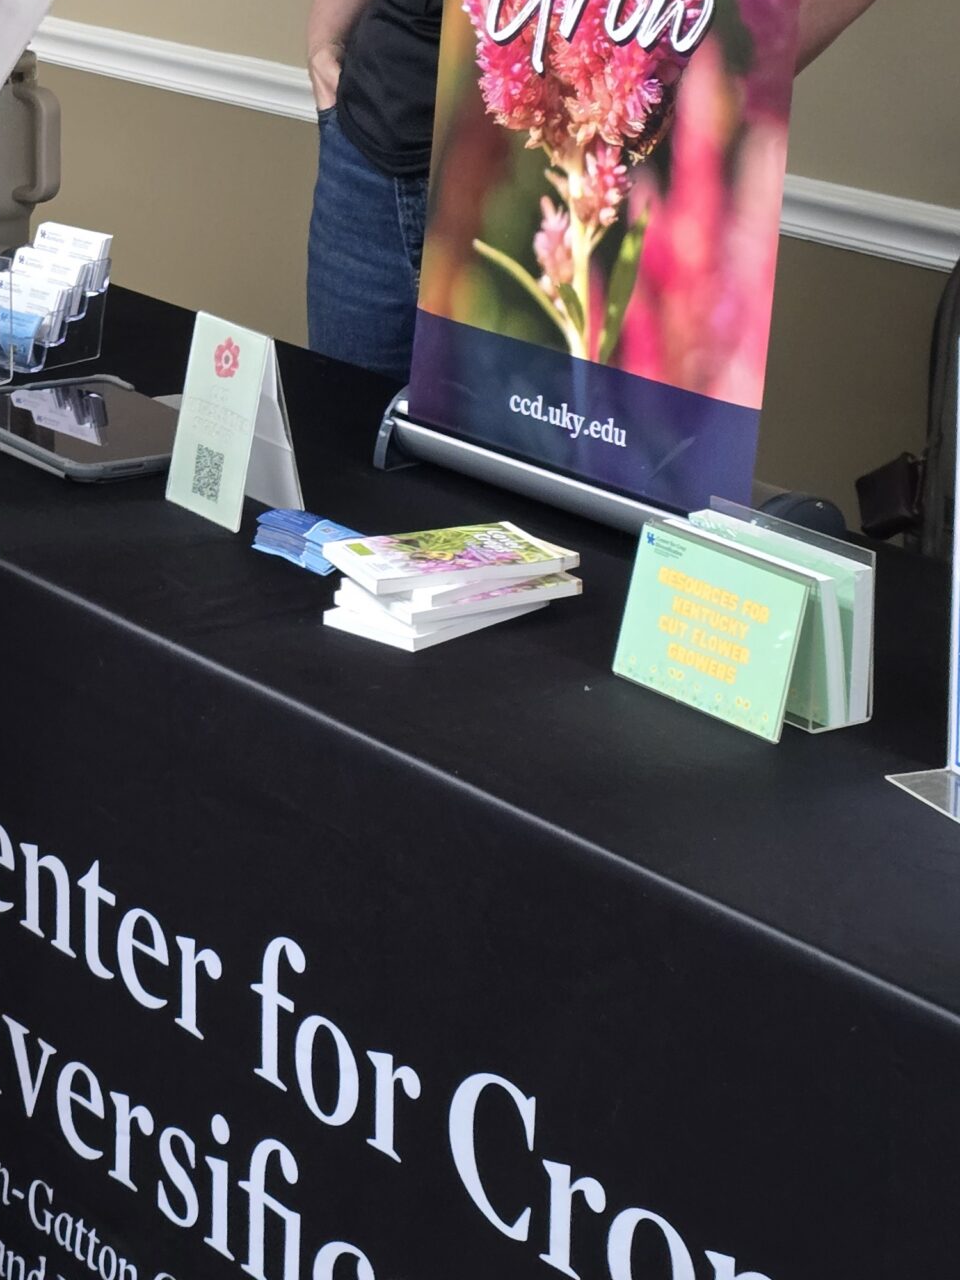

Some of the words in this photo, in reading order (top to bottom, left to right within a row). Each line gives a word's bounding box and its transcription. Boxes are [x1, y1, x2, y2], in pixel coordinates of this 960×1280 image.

[509, 394, 627, 448] ccd.uky.edu
[658, 565, 739, 612] RESOURCES
[742, 599, 770, 624] FOR
[672, 595, 749, 640] KENTUCKY
[658, 615, 688, 639] CUT
[692, 628, 750, 666] FLOWER
[667, 642, 737, 685] GROWERS
[250, 936, 421, 1163] for
[448, 1072, 774, 1280] Cro
